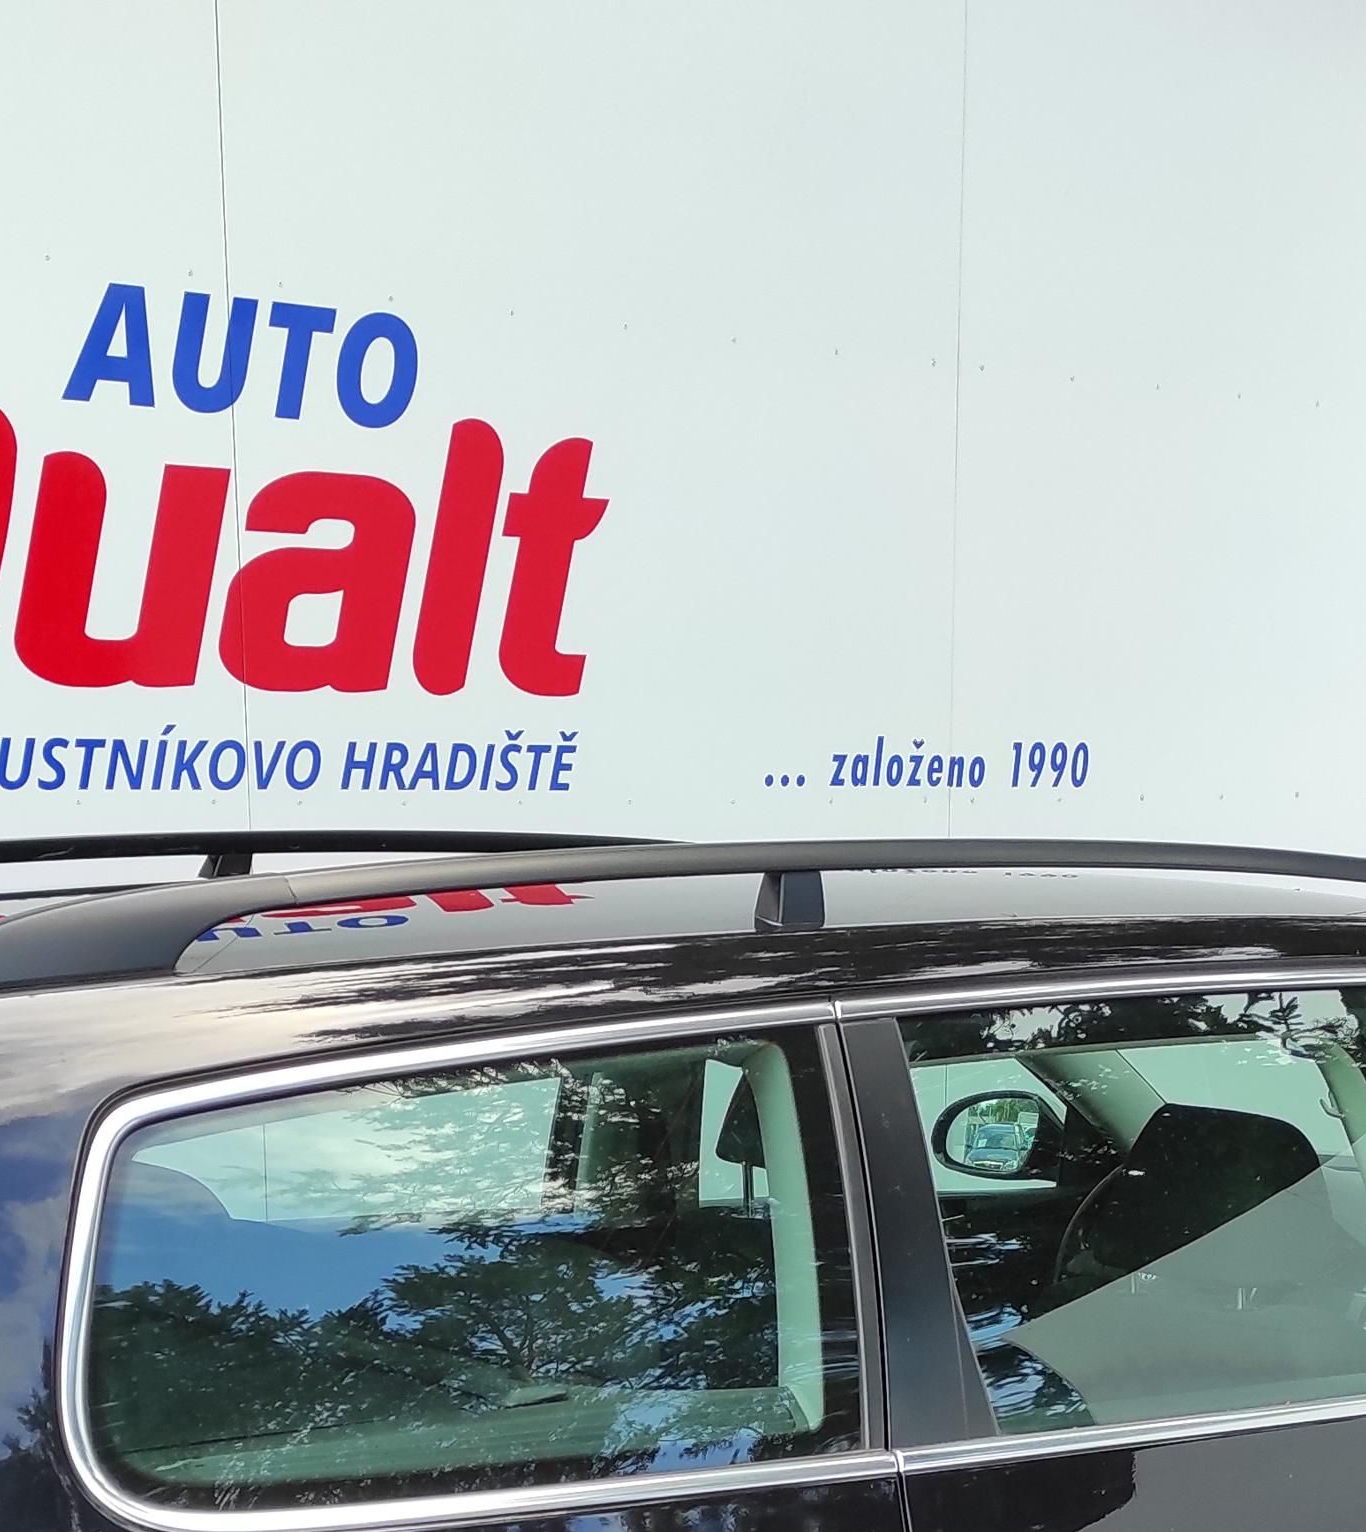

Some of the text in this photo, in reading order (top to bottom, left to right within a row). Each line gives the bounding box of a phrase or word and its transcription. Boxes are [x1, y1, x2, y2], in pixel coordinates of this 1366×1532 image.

[62, 282, 419, 429] AUTO
[340, 730, 577, 792] HRADIŠTĚ
[830, 735, 986, 788] založeno
[1012, 741, 1089, 788] 1990
